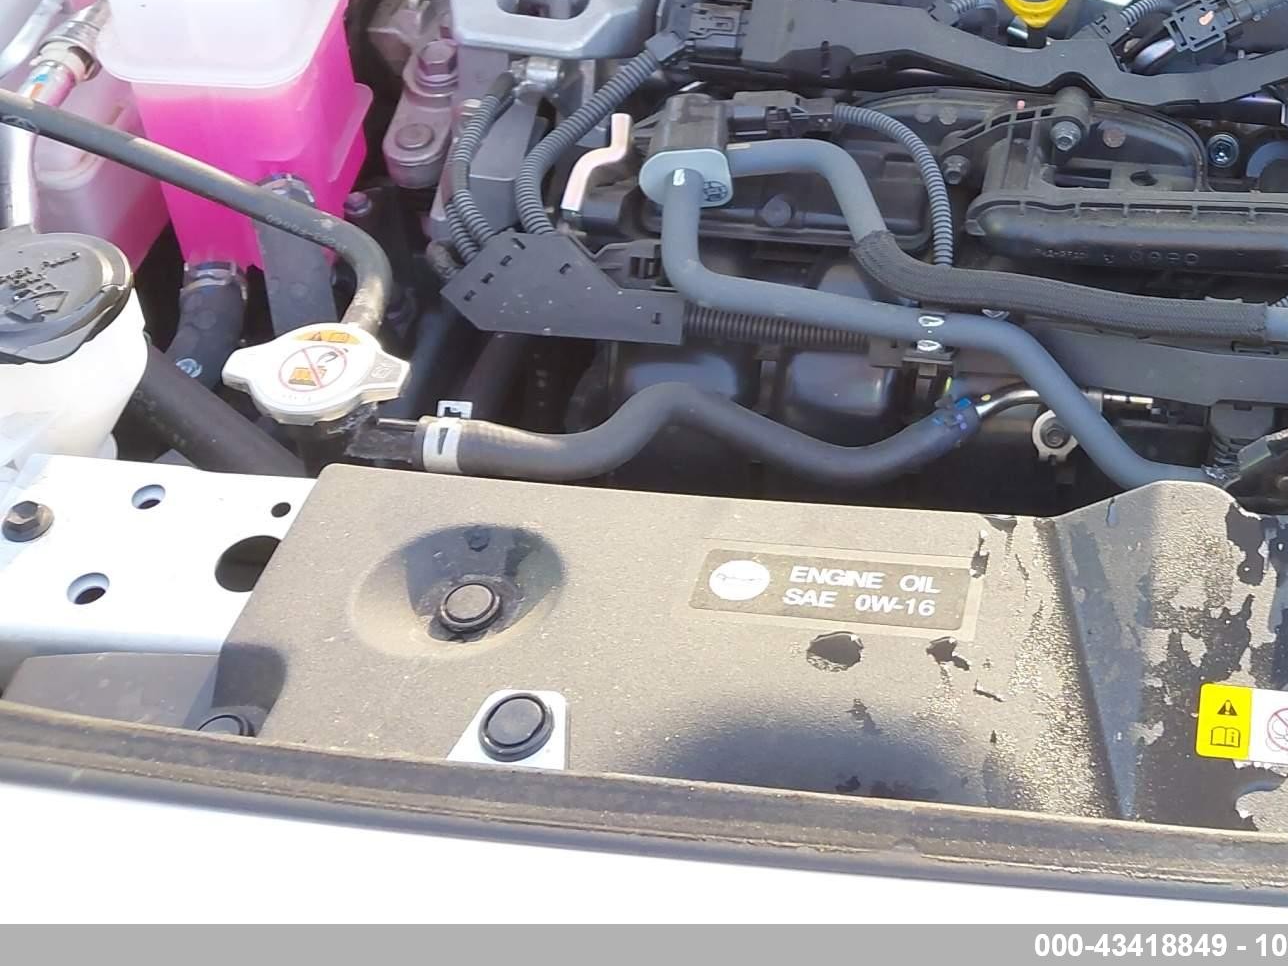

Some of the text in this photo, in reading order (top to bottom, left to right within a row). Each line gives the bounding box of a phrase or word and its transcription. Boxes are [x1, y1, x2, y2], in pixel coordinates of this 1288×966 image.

[789, 565, 886, 590] ENGINE
[899, 574, 942, 594] OIL
[782, 588, 936, 617] SAE 0W-16
